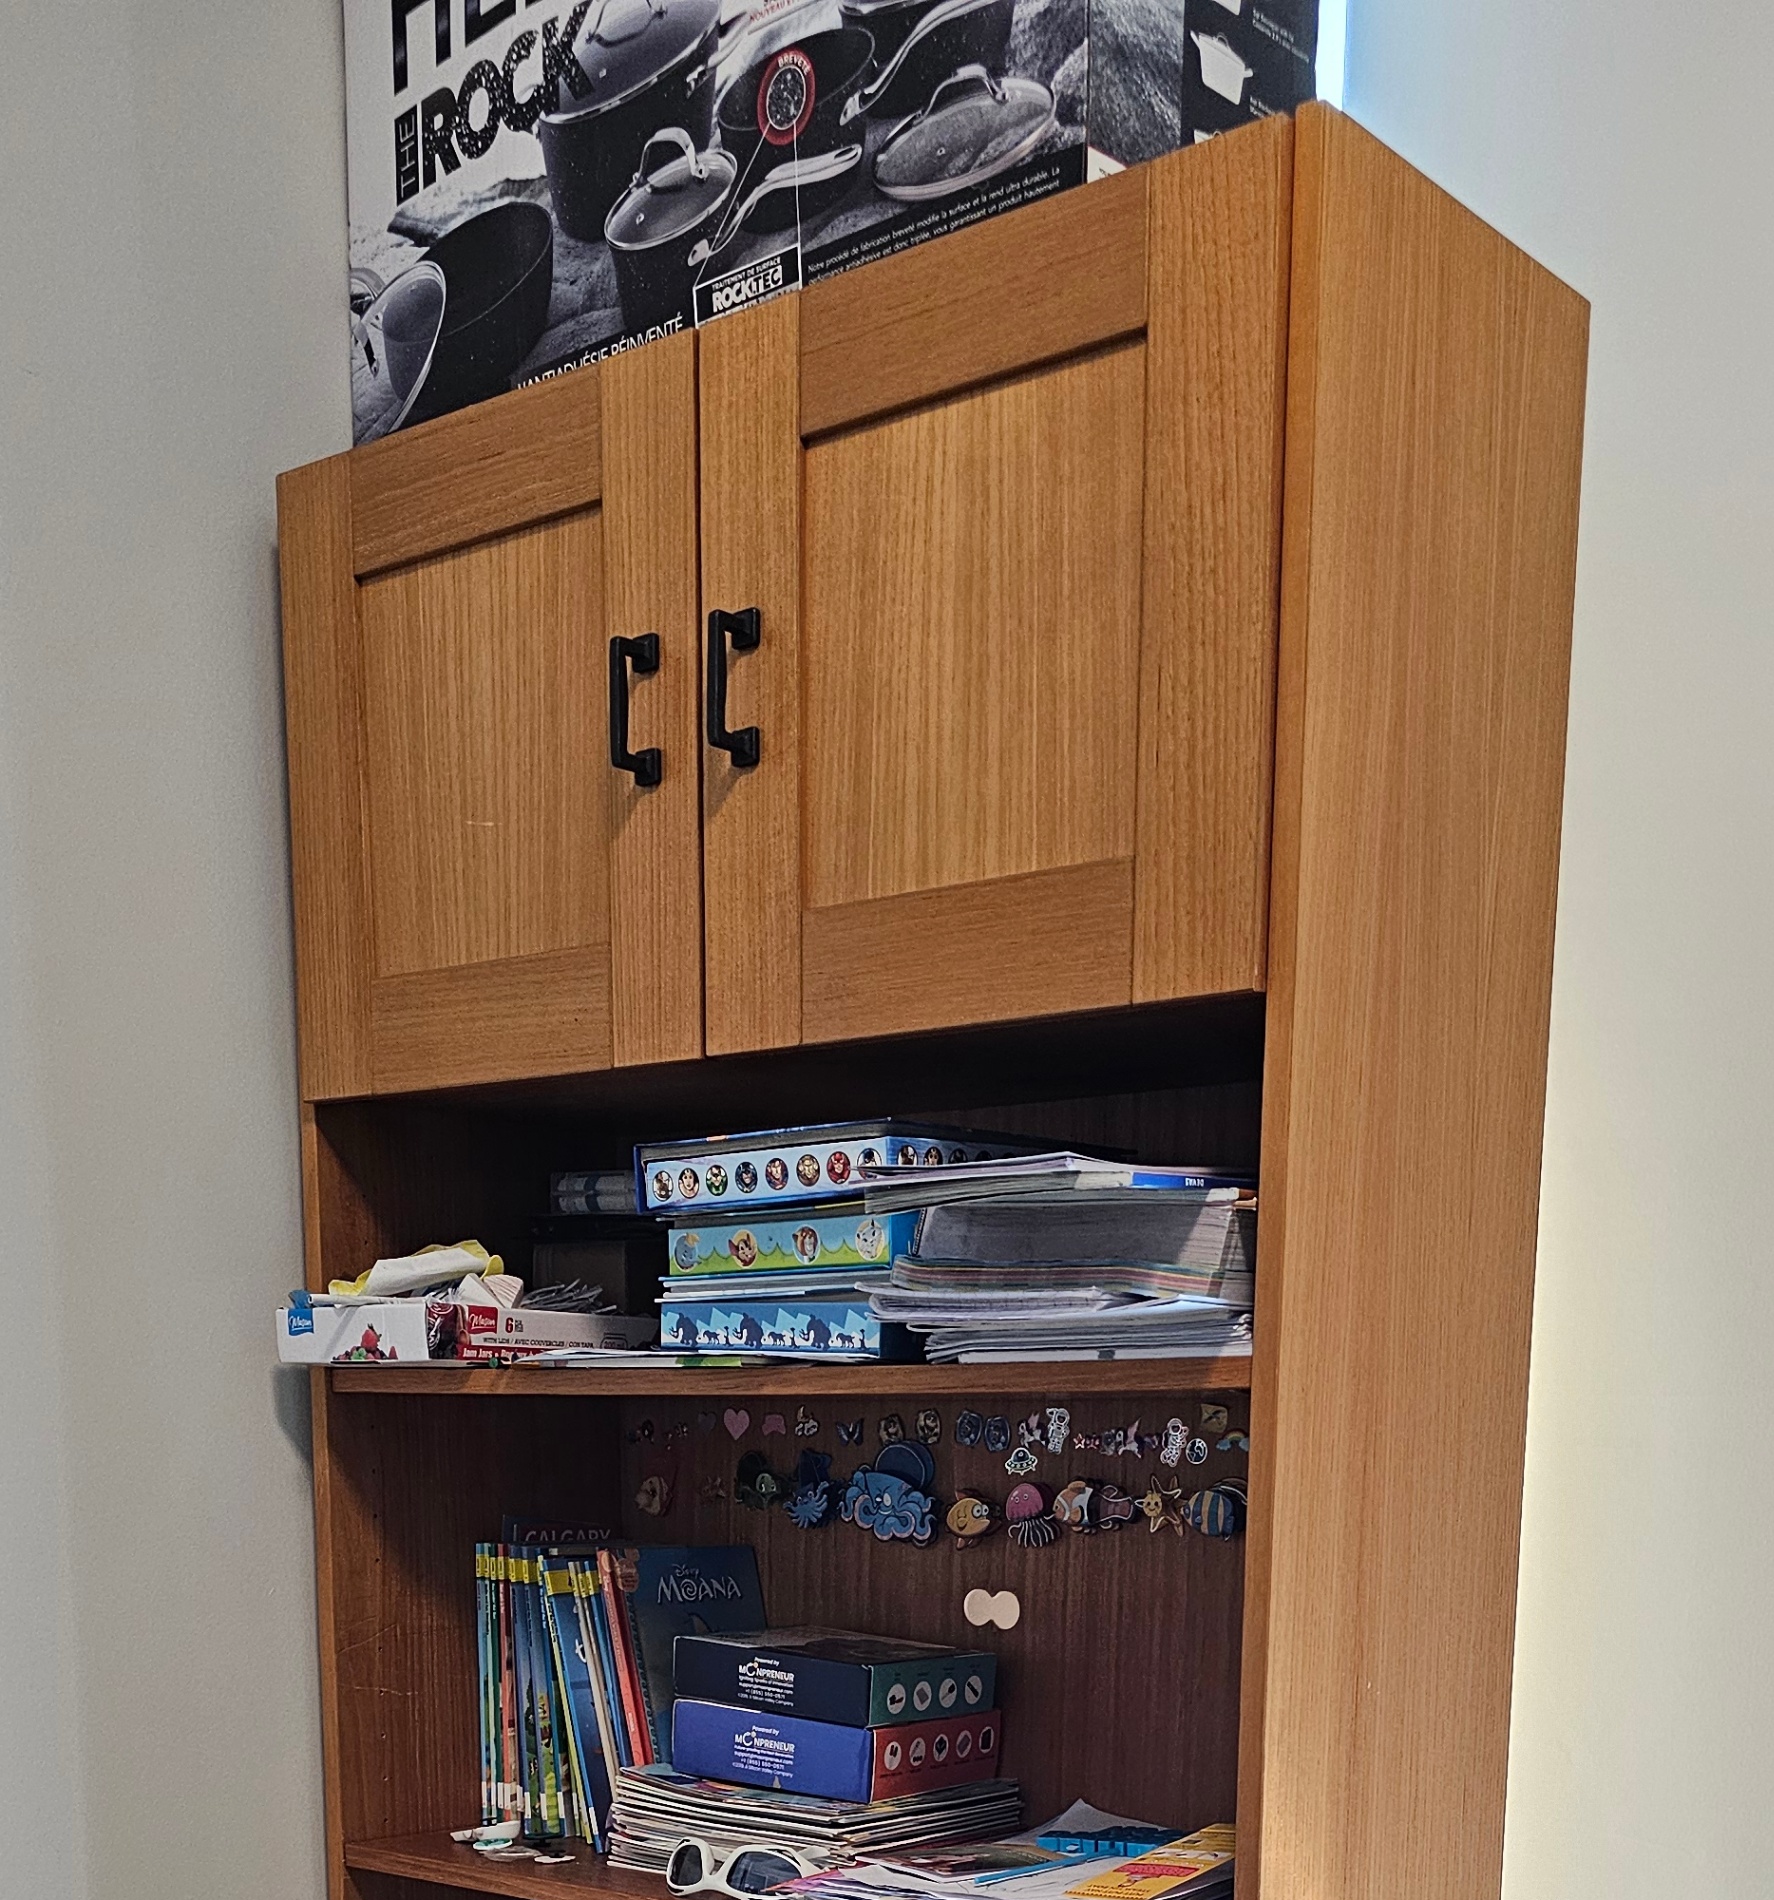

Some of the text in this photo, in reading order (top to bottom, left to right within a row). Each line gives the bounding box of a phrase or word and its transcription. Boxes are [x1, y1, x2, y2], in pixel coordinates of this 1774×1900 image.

[420, 0, 597, 190] ROCK
[399, 113, 416, 199] THE
[1052, 166, 1060, 176] La
[712, 256, 780, 291] TRAITEMENT DE SURFACE
[611, 311, 683, 357] RÉINVENTÉ
[468, 1314, 496, 1328] Mason
[505, 1317, 514, 1334] 6
[462, 1347, 477, 1358] Jam
[478, 1348, 493, 1359] Jars
[531, 1340, 564, 1348] COUVERCLES
[657, 1574, 742, 1604] MOANA
[752, 1725, 780, 1736] Powered by
